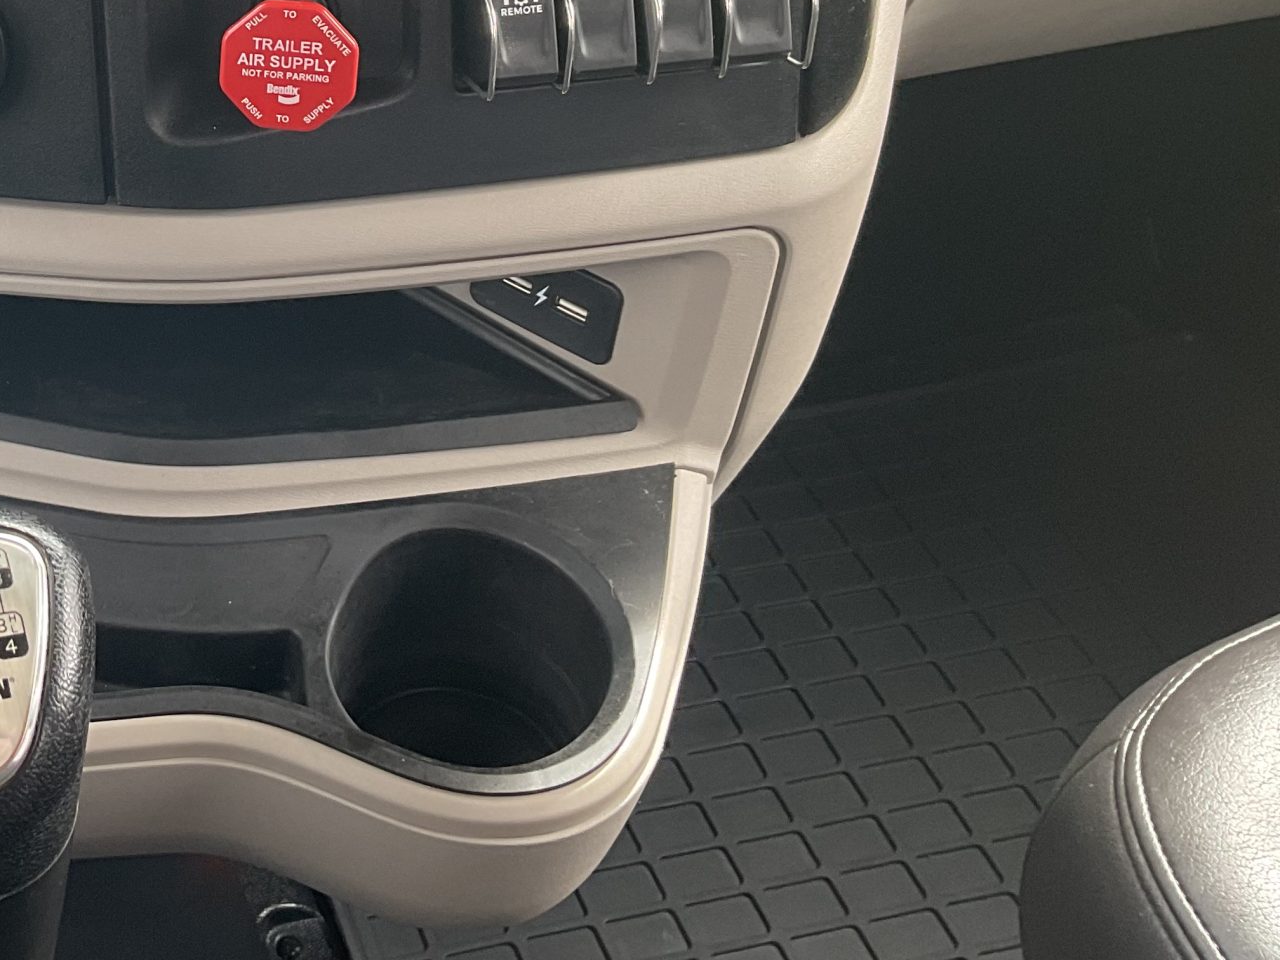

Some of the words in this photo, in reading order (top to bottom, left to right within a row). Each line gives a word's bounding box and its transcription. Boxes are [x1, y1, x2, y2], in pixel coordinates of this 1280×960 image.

[500, 4, 544, 18] REMOTE
[244, 12, 269, 31] PULL
[283, 9, 297, 19] TO
[311, 15, 352, 57] EVACUATE
[252, 37, 323, 56] TRAILER
[236, 52, 265, 67] AIR
[270, 55, 337, 73] SUPPLY
[241, 68, 262, 78] NOT
[264, 70, 284, 80] FOR
[286, 72, 330, 83] PARKING
[266, 83, 300, 96] Bendix
[241, 97, 263, 120] PUSH
[276, 114, 290, 124] TO
[303, 97, 335, 124] SUPPLY
[5, 639, 18, 655] 4
